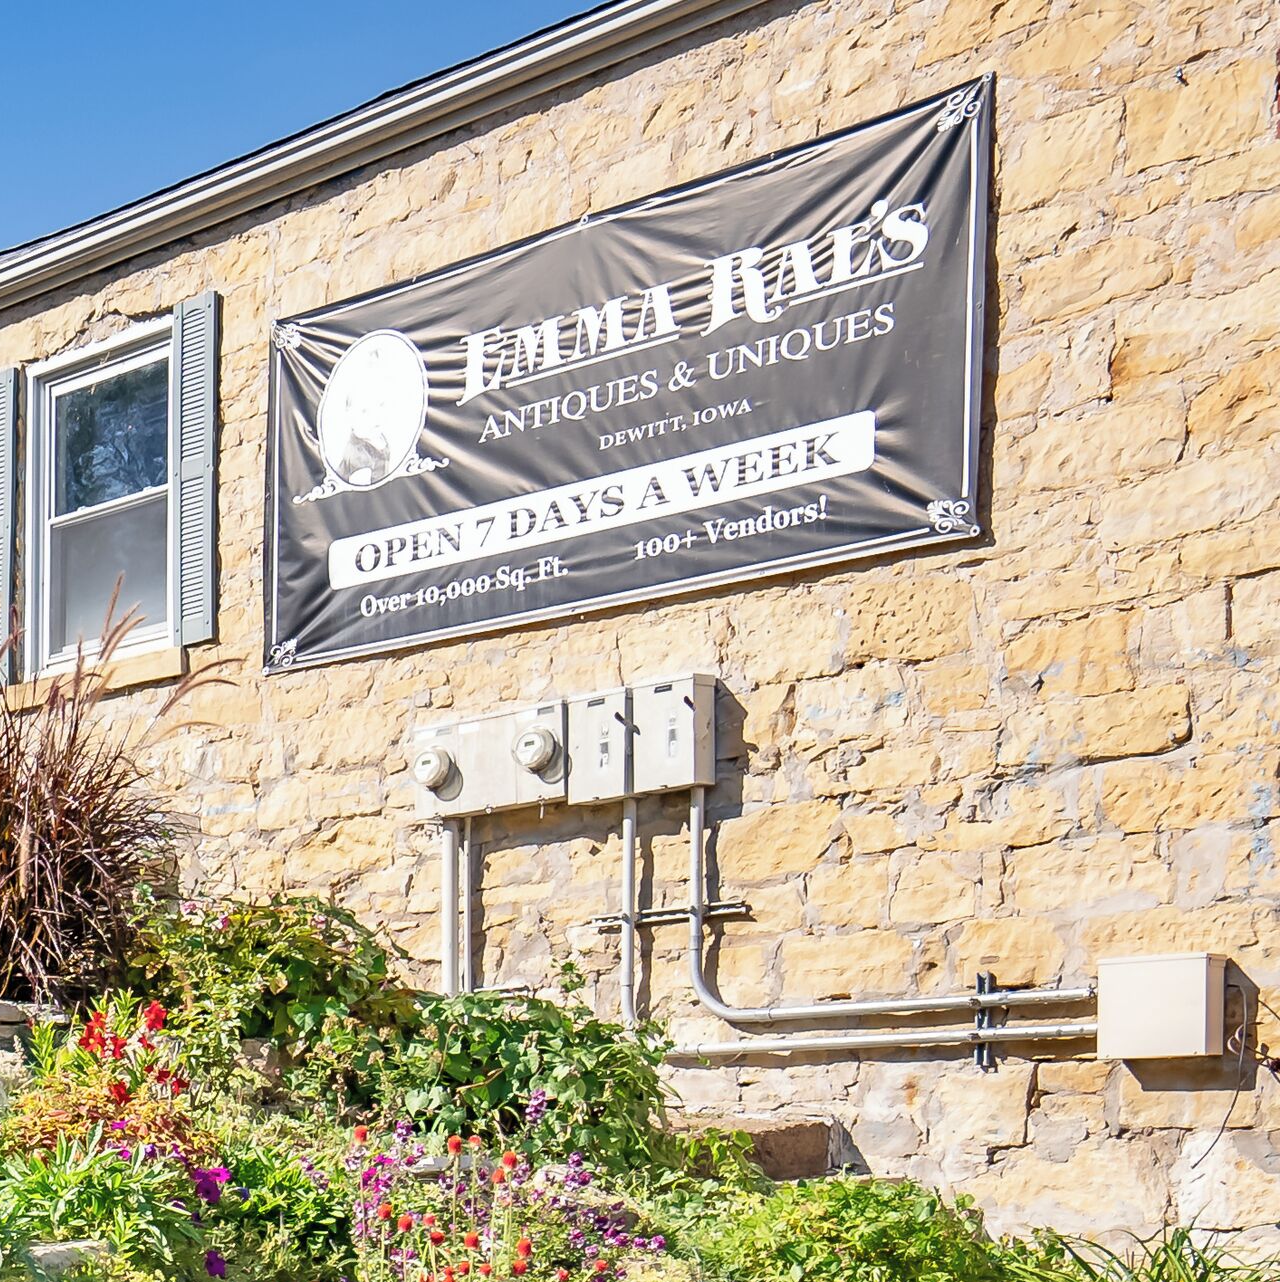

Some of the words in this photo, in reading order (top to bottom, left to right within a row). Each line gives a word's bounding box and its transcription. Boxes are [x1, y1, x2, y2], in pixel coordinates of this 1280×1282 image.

[456, 284, 679, 407] EMMA
[700, 199, 930, 336] RAE'S
[478, 370, 658, 444] ANTIQUES
[668, 361, 695, 392] &
[706, 303, 895, 380] UNIQUES
[598, 416, 688, 450] DEWITT,
[692, 399, 752, 427] IOWA
[355, 515, 462, 575] OPEN
[477, 516, 496, 549] 7
[509, 483, 625, 539] DAYS
[636, 475, 671, 510] A
[683, 432, 841, 497] WEEK
[634, 526, 697, 561] 100+
[703, 495, 829, 546] Vendors!
[360, 590, 410, 618] Over
[416, 571, 490, 604] 10,000
[495, 563, 533, 593] Sq.
[537, 555, 569, 578] Ft.
